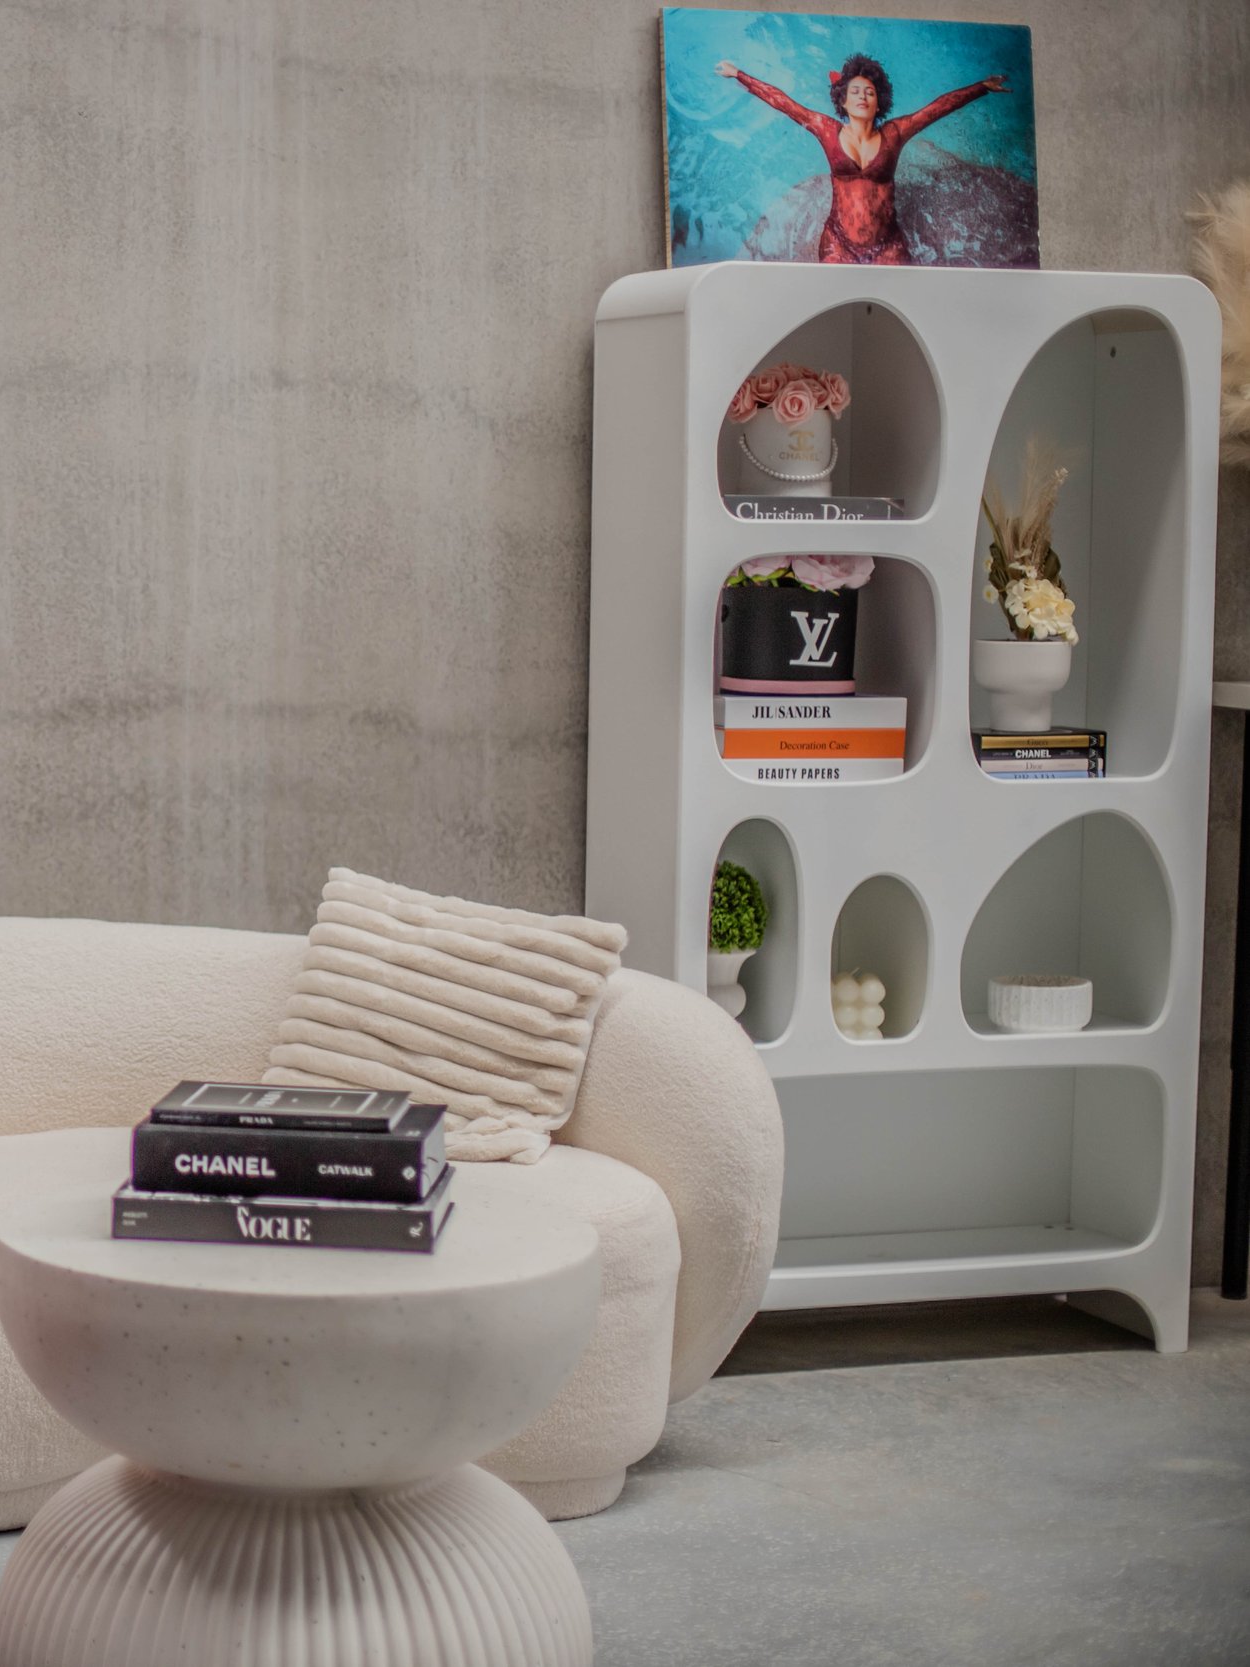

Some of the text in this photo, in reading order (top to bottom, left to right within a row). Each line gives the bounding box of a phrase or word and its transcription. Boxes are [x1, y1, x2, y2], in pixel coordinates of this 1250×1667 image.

[778, 451, 819, 462] CHANEL
[736, 502, 864, 520] Christian Dior
[752, 706, 831, 719] JIL SANDER
[780, 741, 850, 750] Decoration Case
[1015, 749, 1052, 759] CHANEL
[1025, 762, 1044, 770] Dior
[758, 768, 840, 779] BEAUTY PAPERS
[238, 1115, 275, 1125] PRADA
[174, 1153, 374, 1178] CHANEL CATWALK
[237, 1215, 312, 1241] VOGUE
